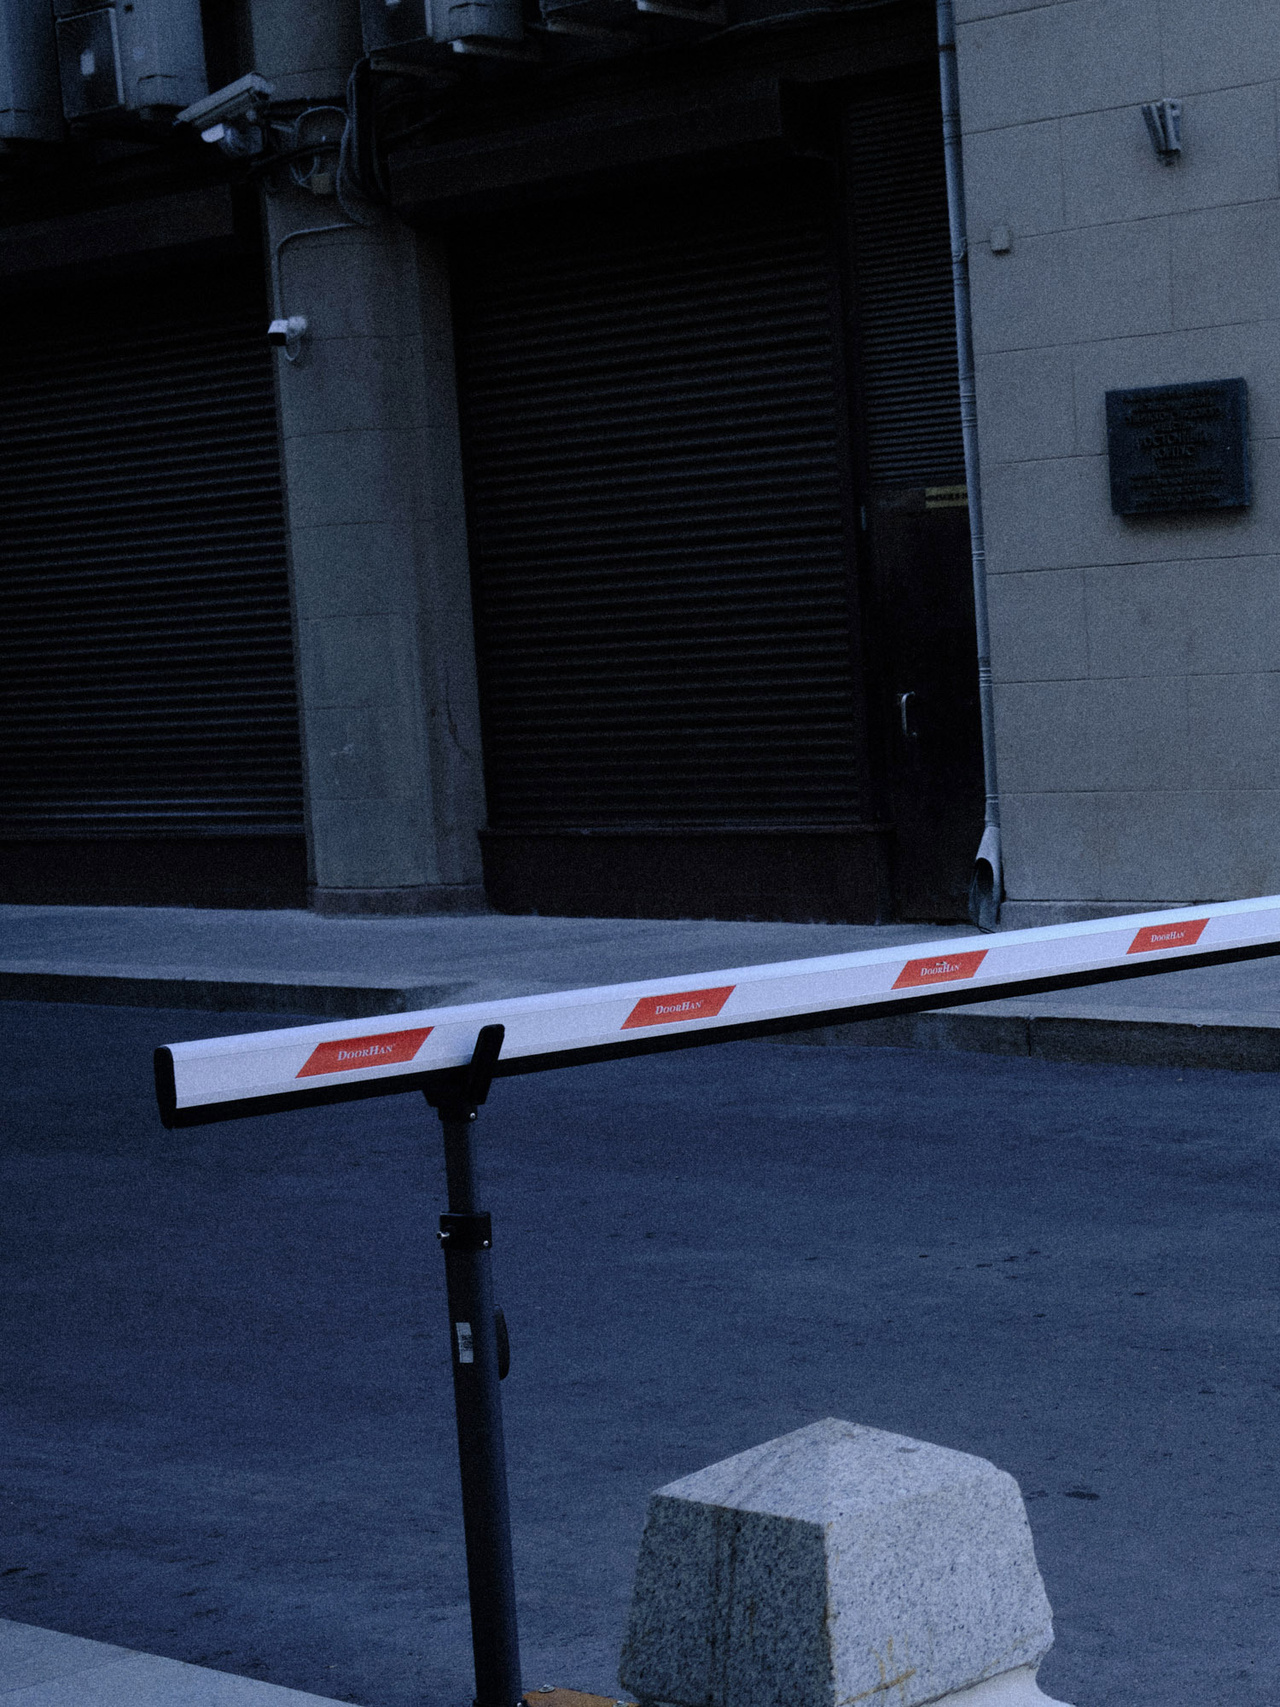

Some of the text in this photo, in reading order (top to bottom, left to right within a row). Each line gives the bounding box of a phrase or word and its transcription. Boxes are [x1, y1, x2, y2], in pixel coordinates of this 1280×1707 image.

[1150, 931, 1185, 942] DOORHAN
[920, 963, 960, 976] DOORHAN
[655, 1001, 702, 1016] DOORHAN
[337, 1044, 393, 1061] DOORHAN
